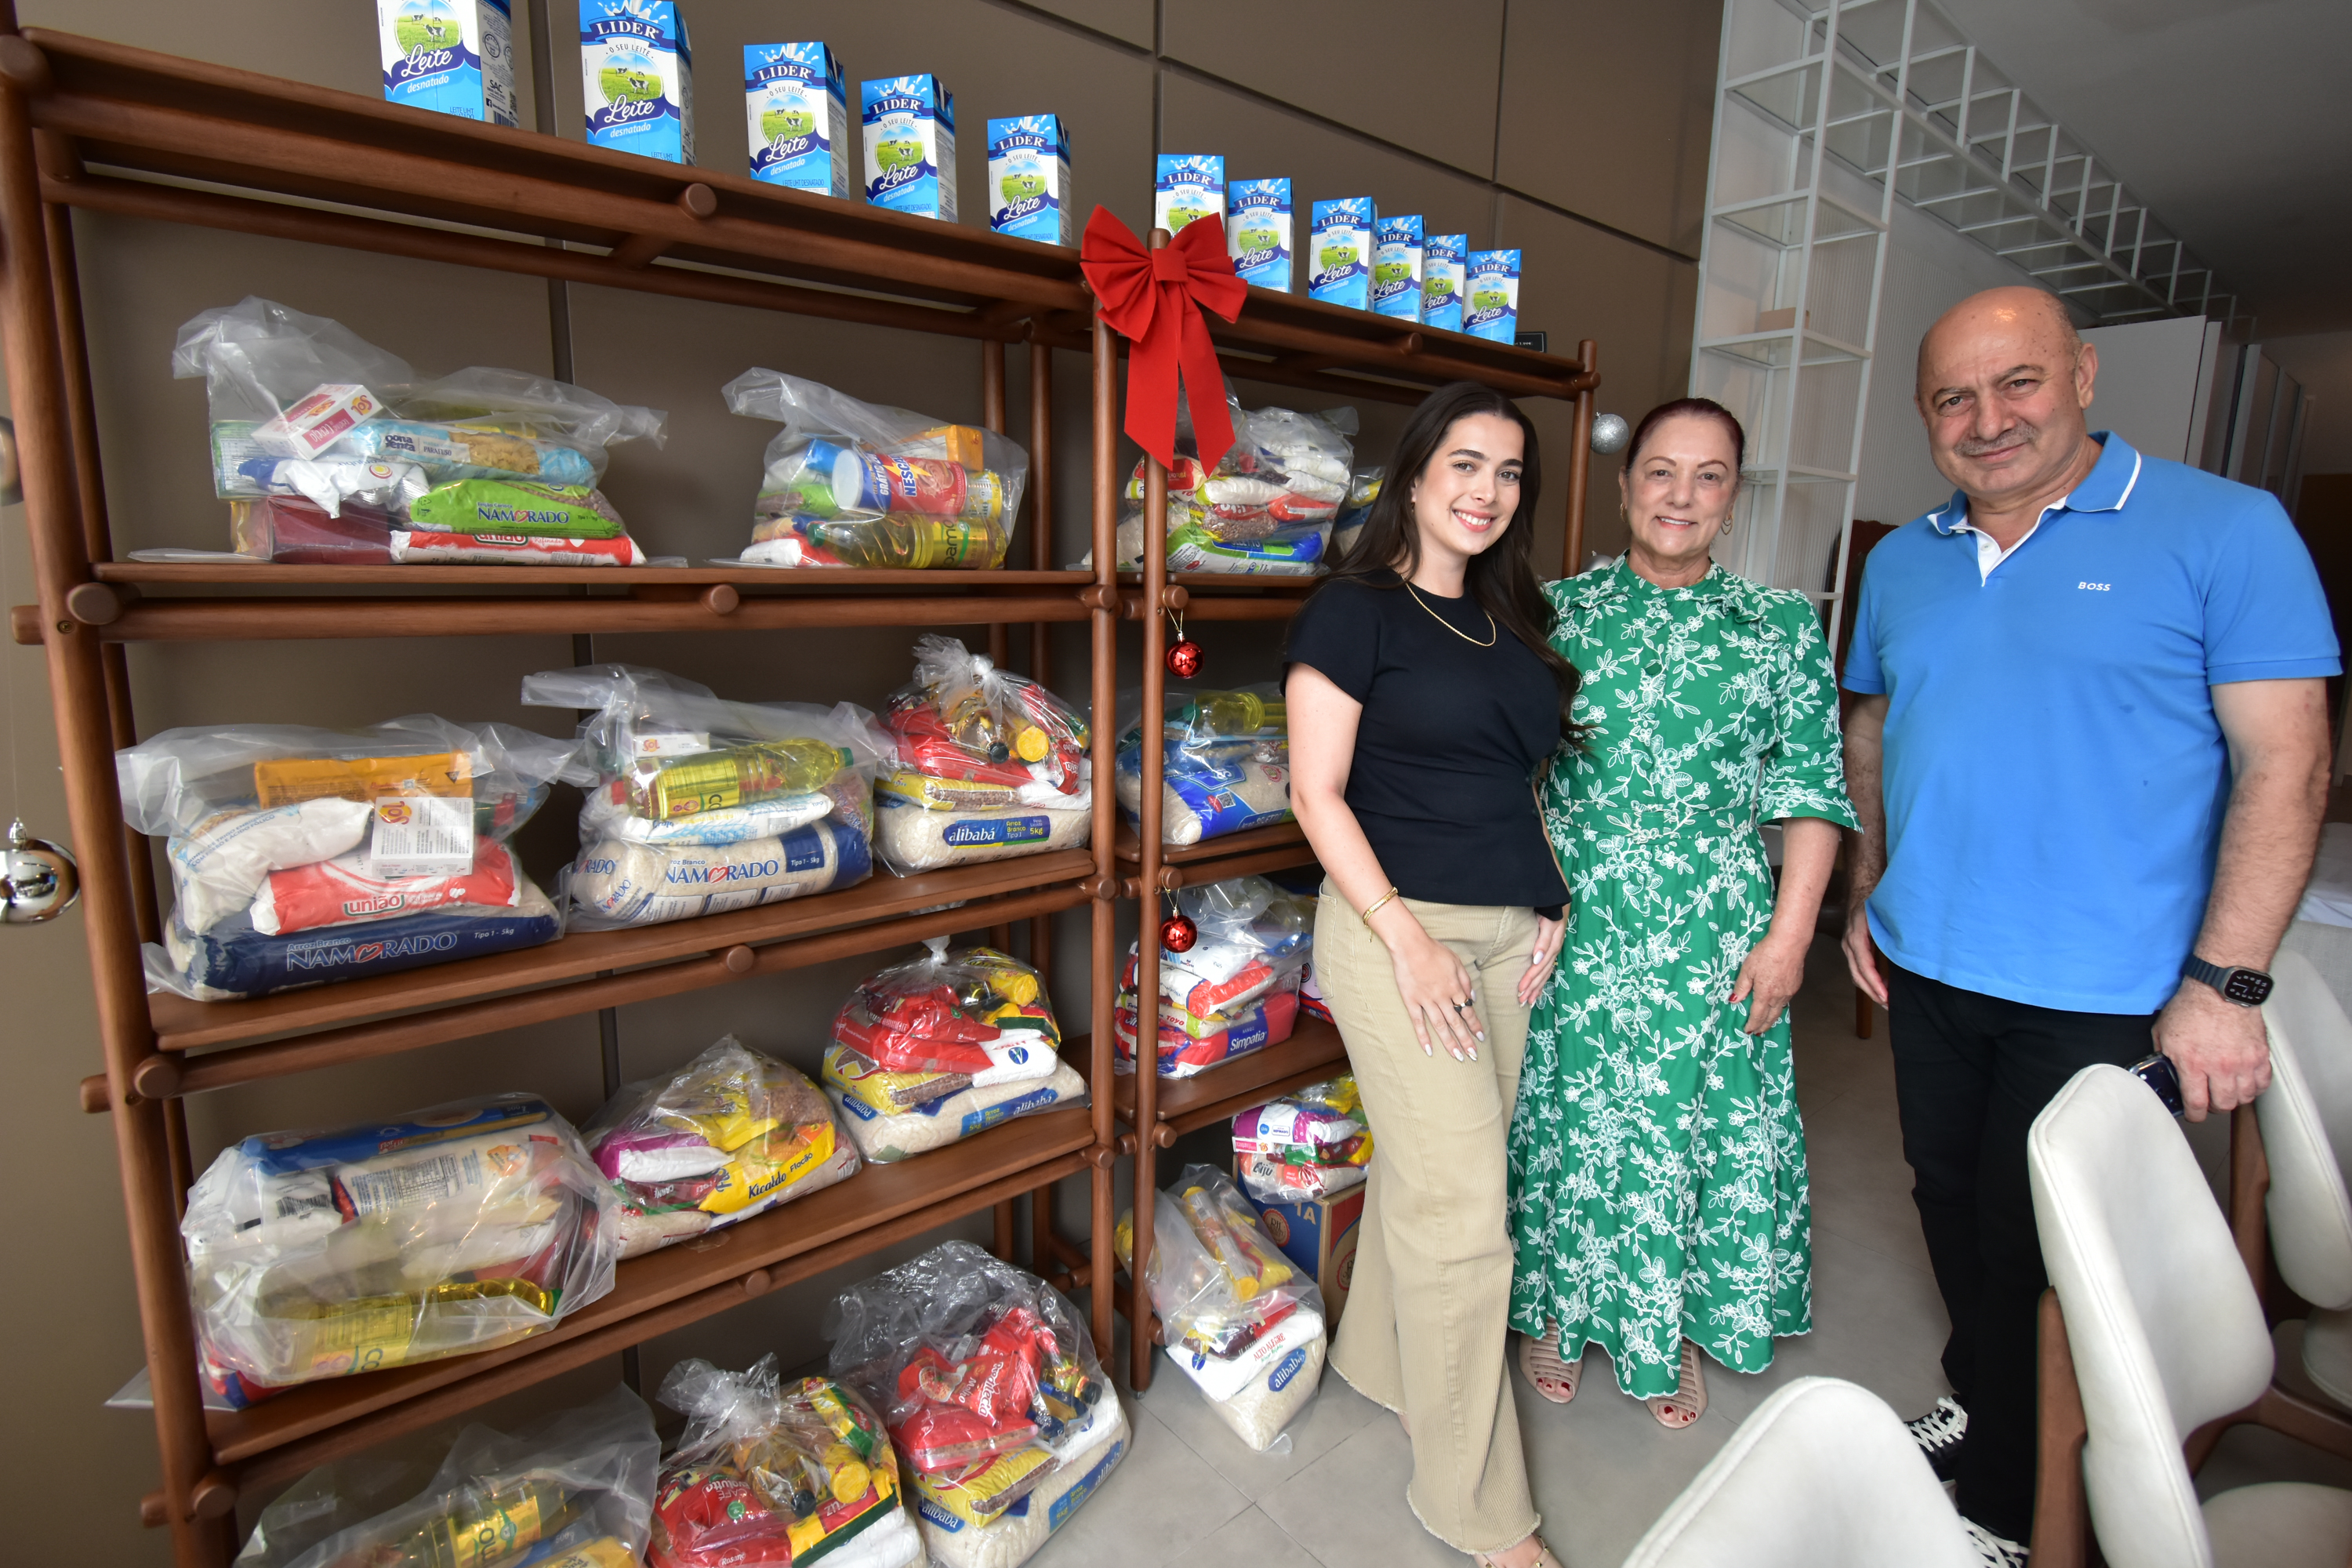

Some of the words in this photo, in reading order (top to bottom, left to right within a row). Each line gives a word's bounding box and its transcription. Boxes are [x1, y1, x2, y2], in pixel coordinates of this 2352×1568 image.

[597, 21, 656, 39] LIDER
[632, 45, 651, 56] LEITE
[401, 45, 452, 77] Leite
[759, 66, 809, 81] LIDER
[408, 74, 448, 93] desnatado
[490, 80, 503, 93] SAC
[789, 86, 804, 96] LEITE
[604, 95, 655, 123] Leite
[874, 99, 919, 114] LIDER
[610, 123, 651, 137] desnatado
[766, 133, 808, 162] Leite
[1000, 136, 1042, 151] LIDER
[771, 158, 804, 175] desnatado
[880, 164, 918, 190] Leite
[1168, 172, 1209, 185] LIDER
[884, 184, 914, 202] desnatado
[1004, 195, 1040, 220] Leite
[1239, 197, 1278, 208] LIDER
[1008, 216, 1037, 231] desnatado
[1321, 216, 1358, 227] LIDER
[1240, 248, 1272, 268] Leite
[1427, 249, 1454, 258] IDER
[1243, 265, 1270, 278] desnatado
[1320, 263, 1352, 284] Leite
[1475, 264, 1509, 274] LIDER
[1375, 279, 1405, 299] Leite
[1472, 306, 1502, 323] Leite
[2078, 582, 2111, 591] BOSS
[191, 855, 205, 866] COM
[230, 826, 250, 840] ÁCIDO
[251, 814, 275, 828] FÓLICO
[216, 829, 235, 842] TRIGO
[949, 828, 995, 841] alibabá
[349, 895, 401, 913] união
[501, 928, 514, 938] 5kg
[287, 942, 316, 952] Arroz
[316, 937, 351, 948] Branco
[1166, 1015, 1185, 1025] TOYO
[1230, 1030, 1265, 1051] Simpatia
[749, 1172, 786, 1199] Kicaldo
[790, 1152, 813, 1172] Flocão
[1254, 1347, 1267, 1361] ALTO
[1266, 1333, 1286, 1350] ALEGRE
[959, 1377, 976, 1403] Molho
